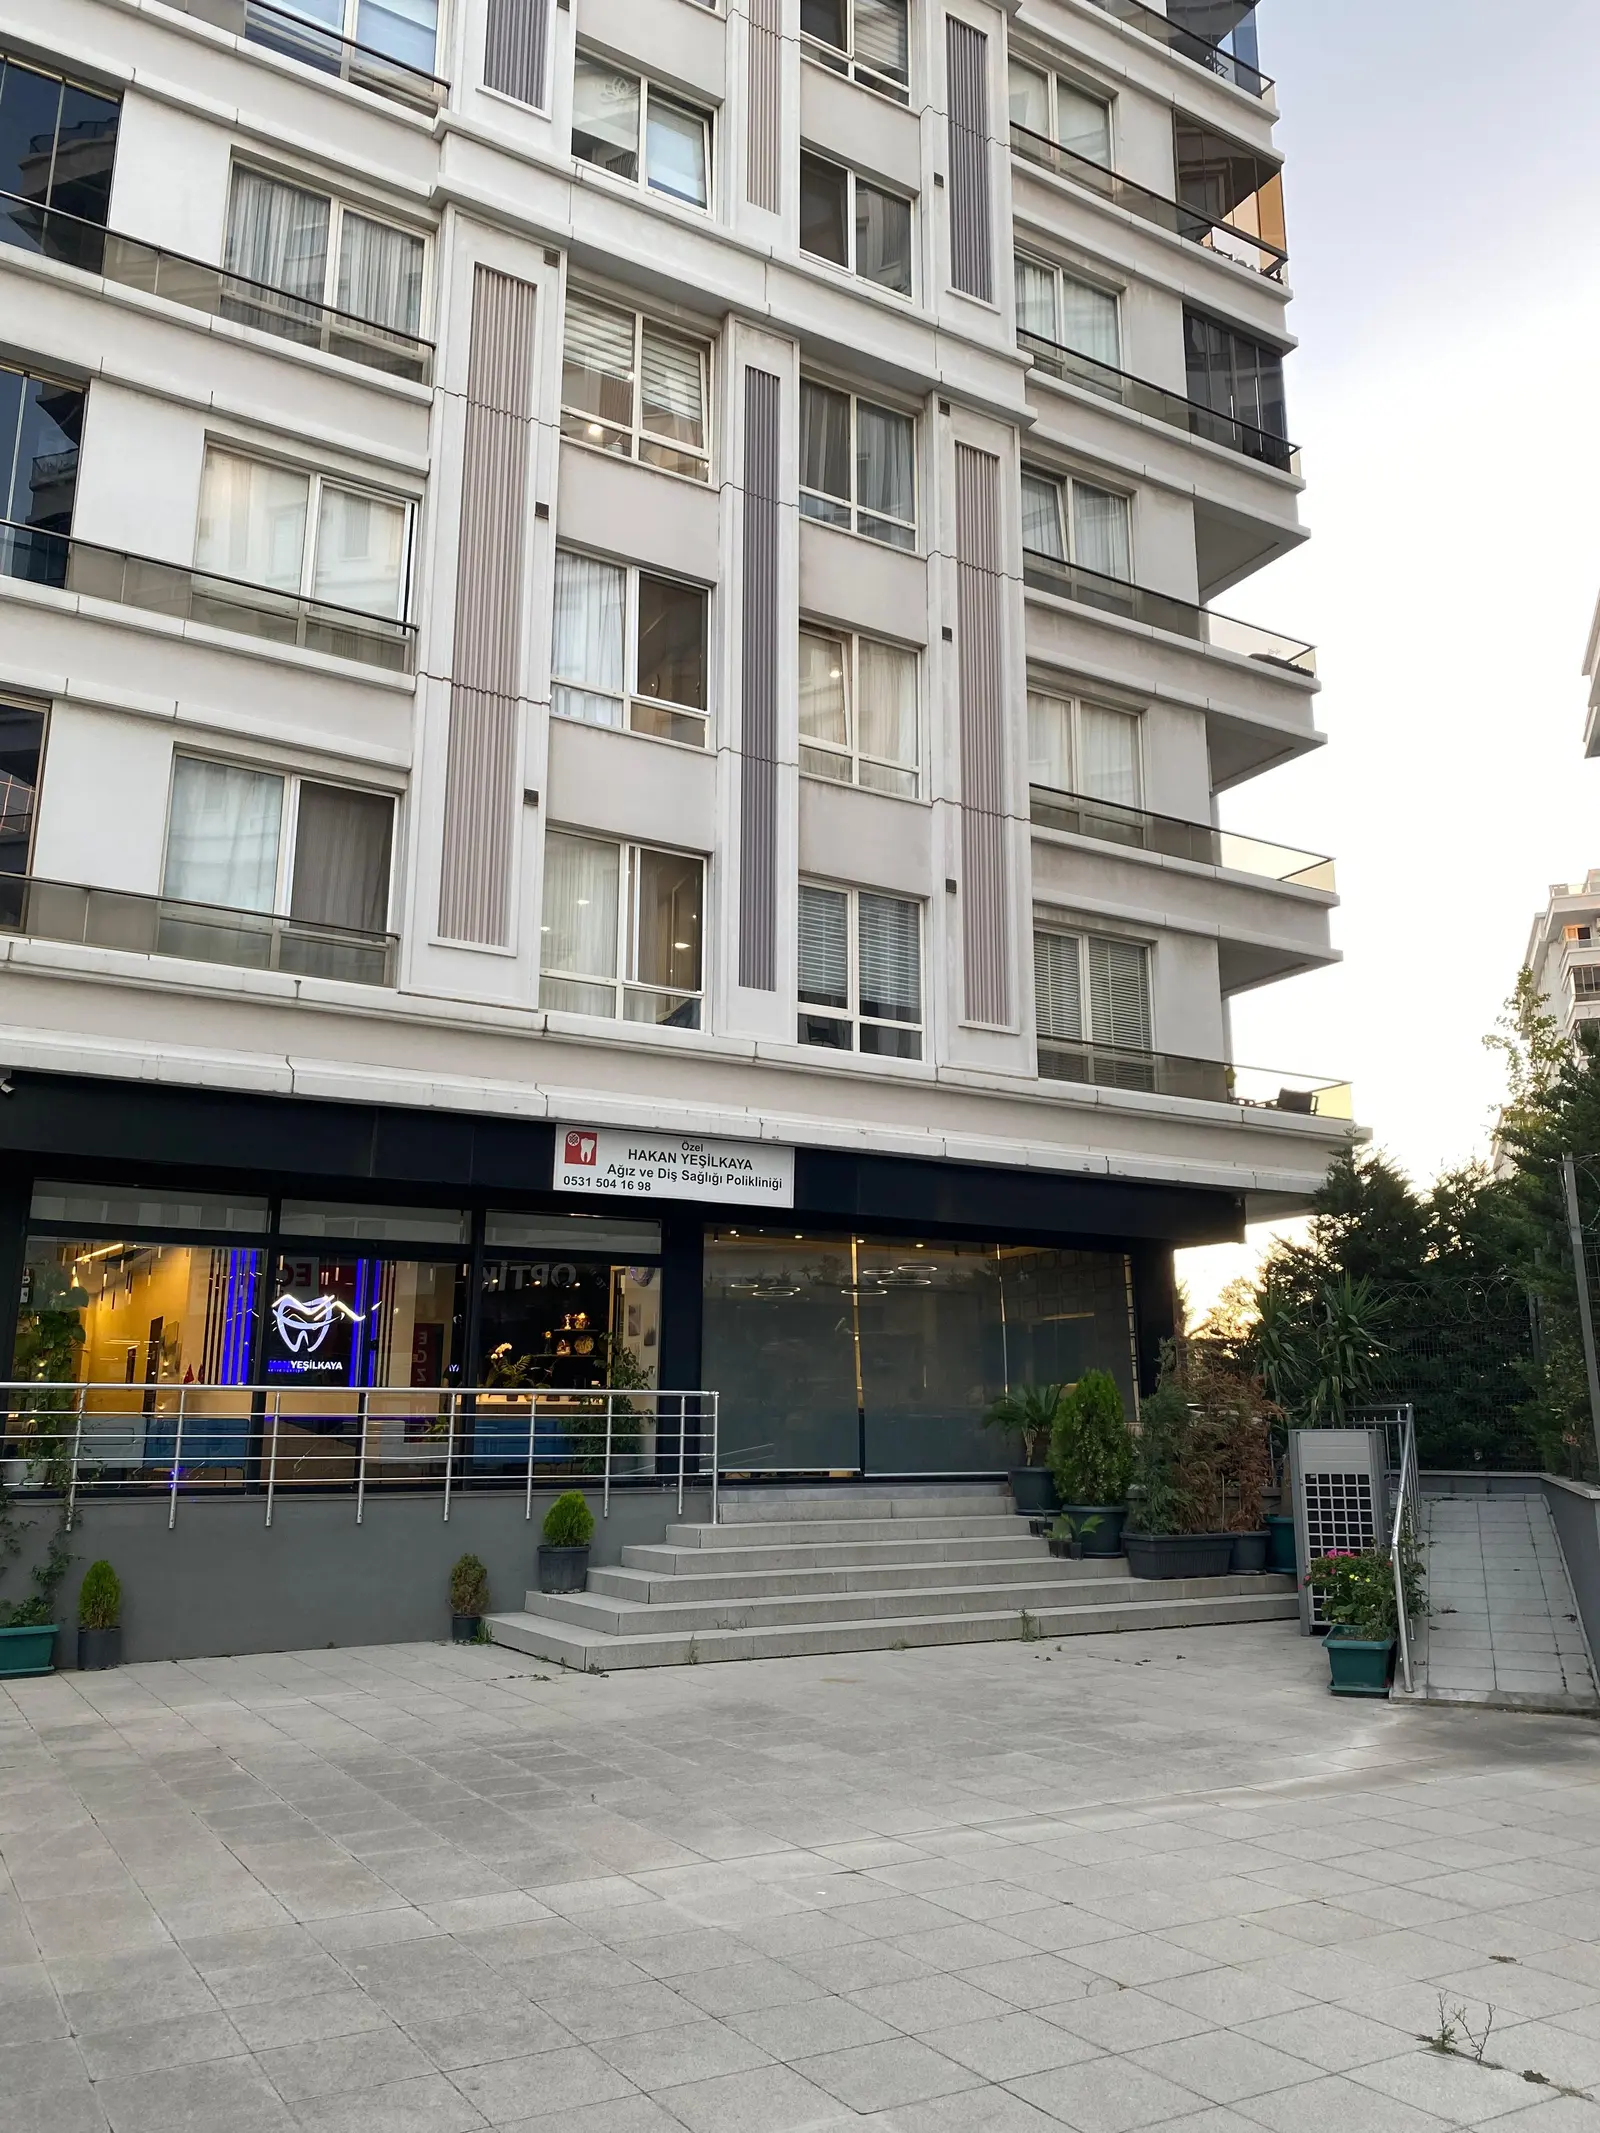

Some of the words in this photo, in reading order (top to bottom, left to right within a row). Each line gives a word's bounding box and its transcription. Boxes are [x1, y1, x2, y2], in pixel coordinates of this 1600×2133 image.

[681, 1140, 704, 1153] Özel
[628, 1148, 677, 1164] HAKAN
[681, 1153, 753, 1171] YEŞİLKAYA
[563, 1175, 592, 1187] 0531
[595, 1178, 617, 1189] 504
[621, 1179, 634, 1190] 16
[637, 1181, 651, 1192] 98
[607, 1163, 636, 1179] Ağız
[639, 1169, 654, 1178] ve
[657, 1168, 678, 1182] Diş
[681, 1170, 723, 1185] Sağlığı
[726, 1174, 783, 1189] Polikliniği
[290, 1359, 343, 1372] YEŞİLKAYA
